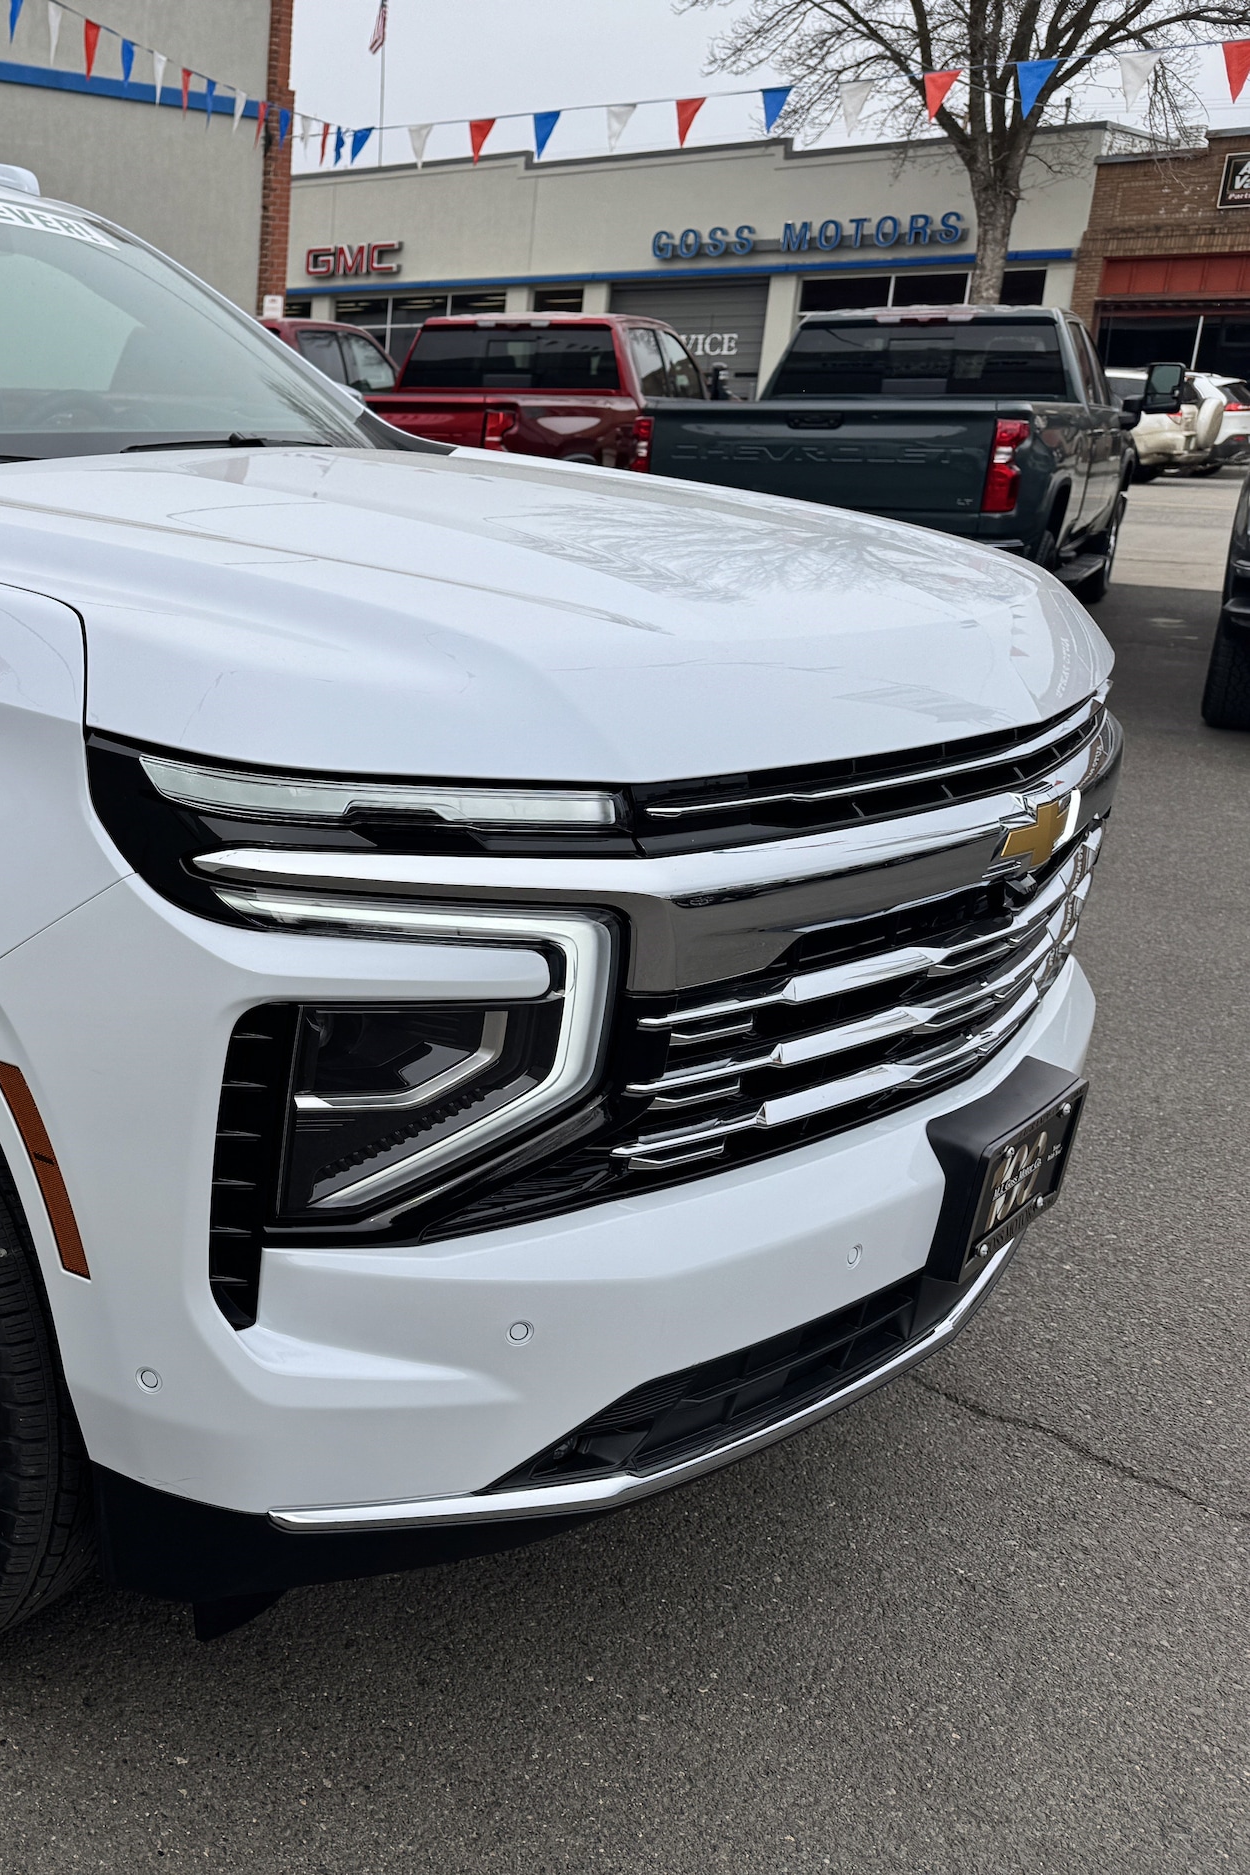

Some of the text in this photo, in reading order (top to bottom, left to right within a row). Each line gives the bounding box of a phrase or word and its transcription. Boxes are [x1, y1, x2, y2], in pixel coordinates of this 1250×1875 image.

[652, 211, 965, 259] GOSS MOTORS
[306, 241, 399, 275] GMC
[670, 444, 964, 464] CHEVROLET
